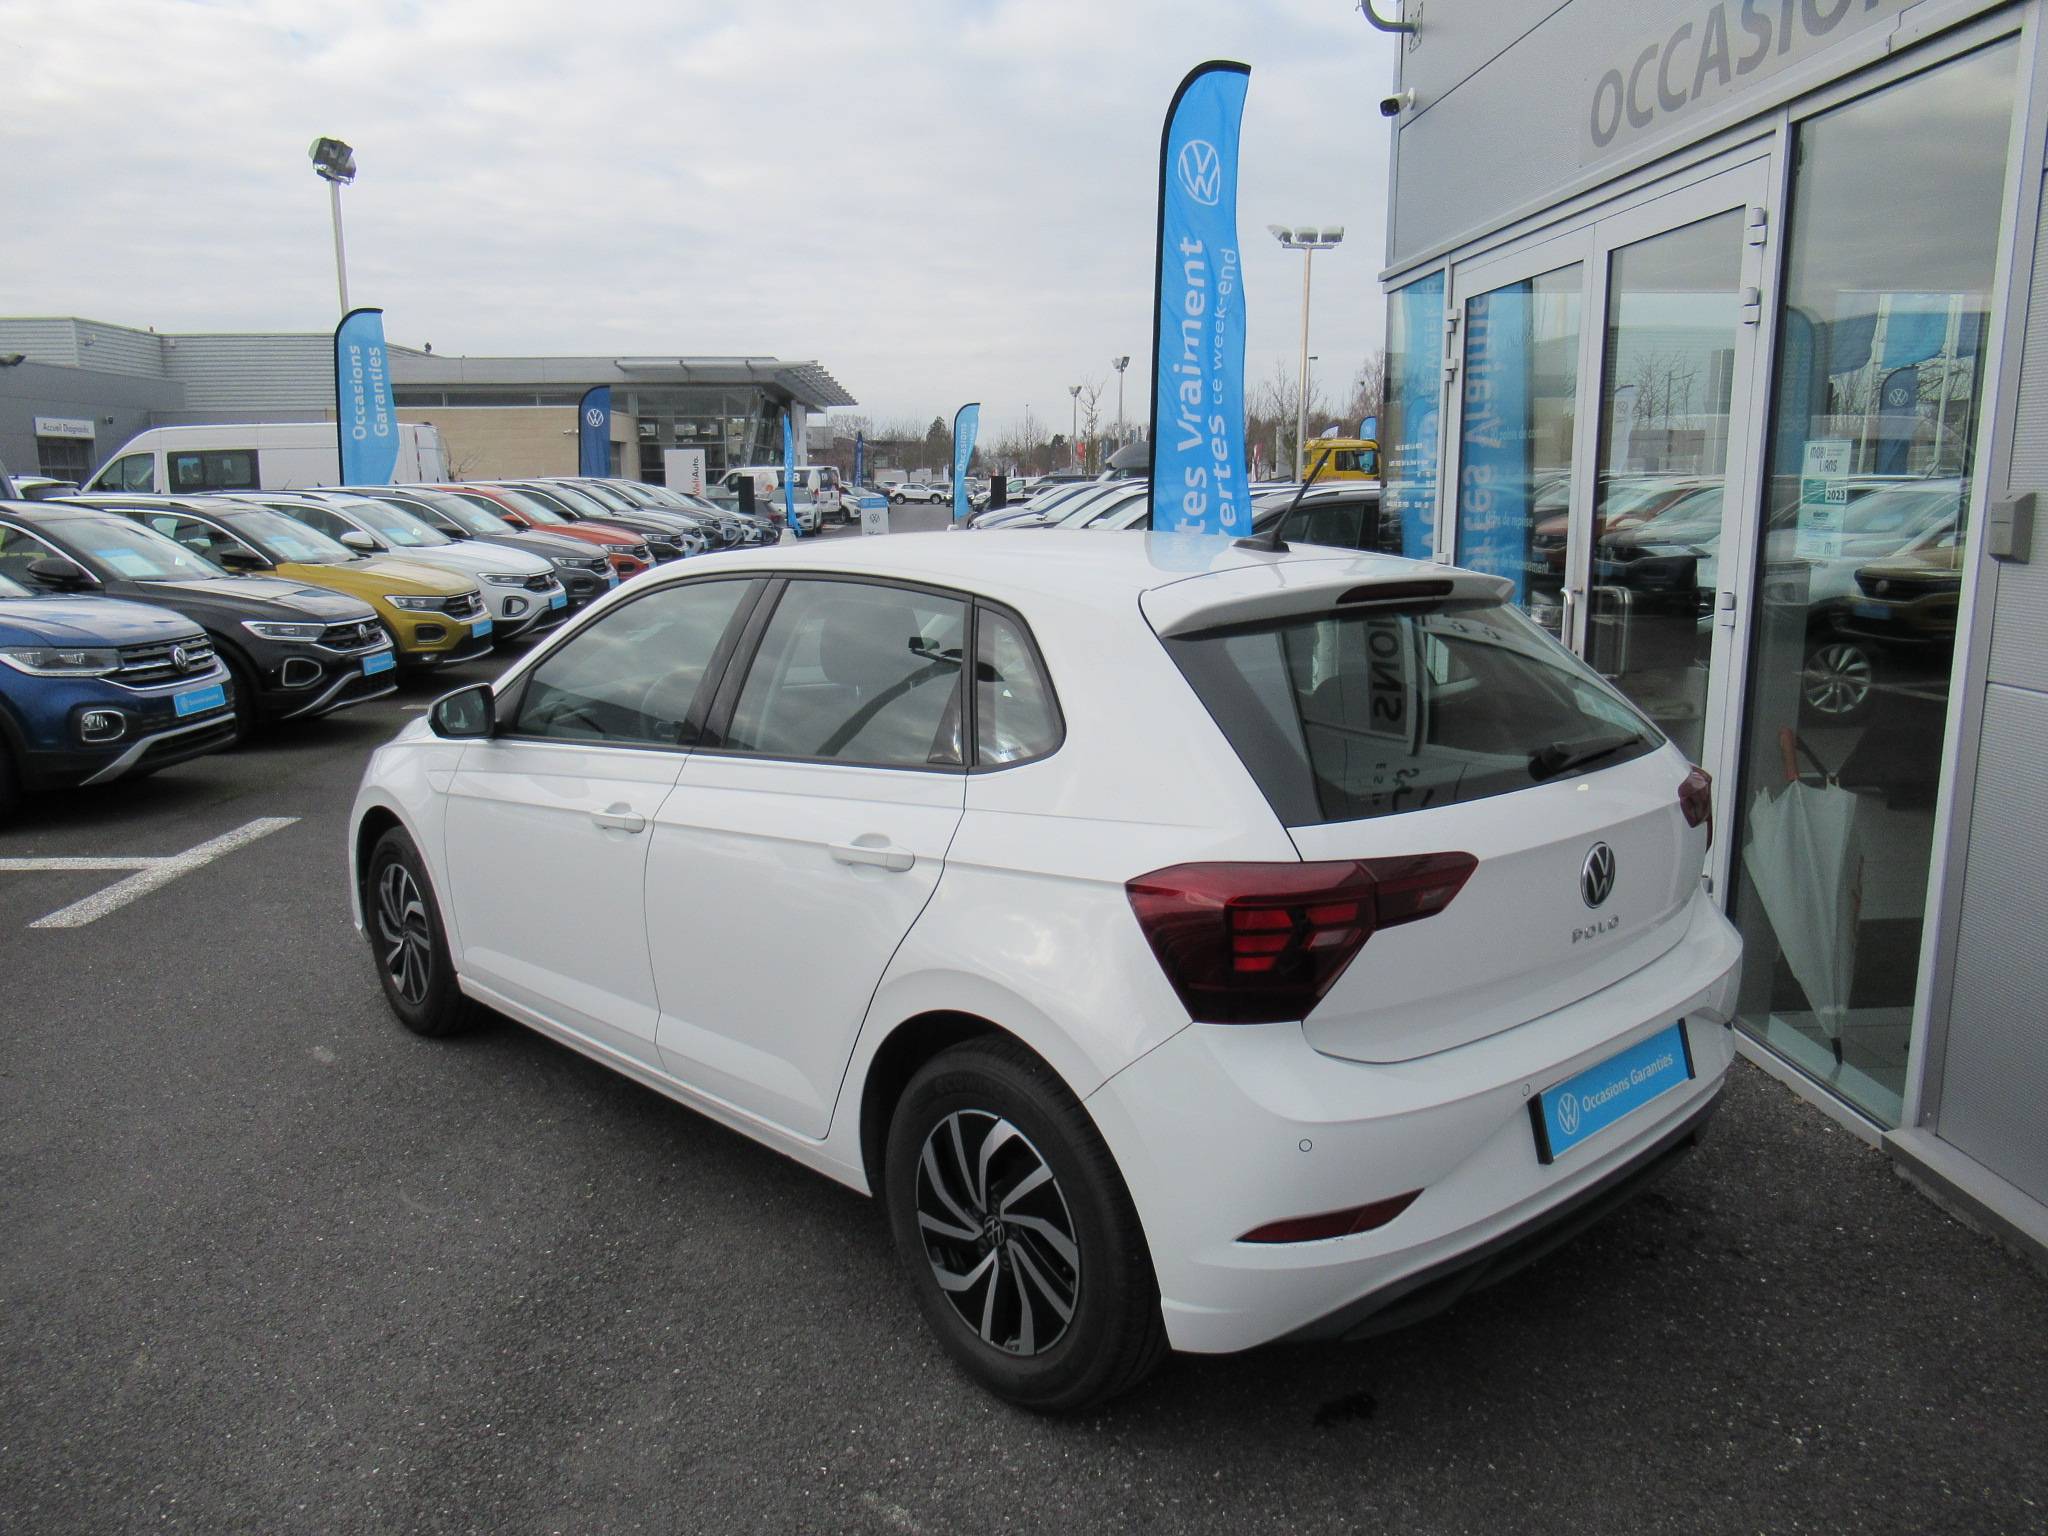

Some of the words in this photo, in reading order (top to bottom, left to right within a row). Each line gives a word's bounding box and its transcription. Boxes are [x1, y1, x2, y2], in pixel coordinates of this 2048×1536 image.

[1590, 0, 1879, 148] OCCASI
[1173, 237, 1205, 452] Vraiment
[1213, 248, 1238, 370] week-end
[350, 345, 367, 441] Occasions
[369, 346, 389, 437] Garanties
[1212, 380, 1224, 405] ce
[1174, 466, 1209, 535] tes
[1827, 490, 1846, 501] 2023
[1571, 914, 1620, 945] POLO
[1582, 1076, 1631, 1113] Occasions
[1630, 1053, 1674, 1085] Garanties
